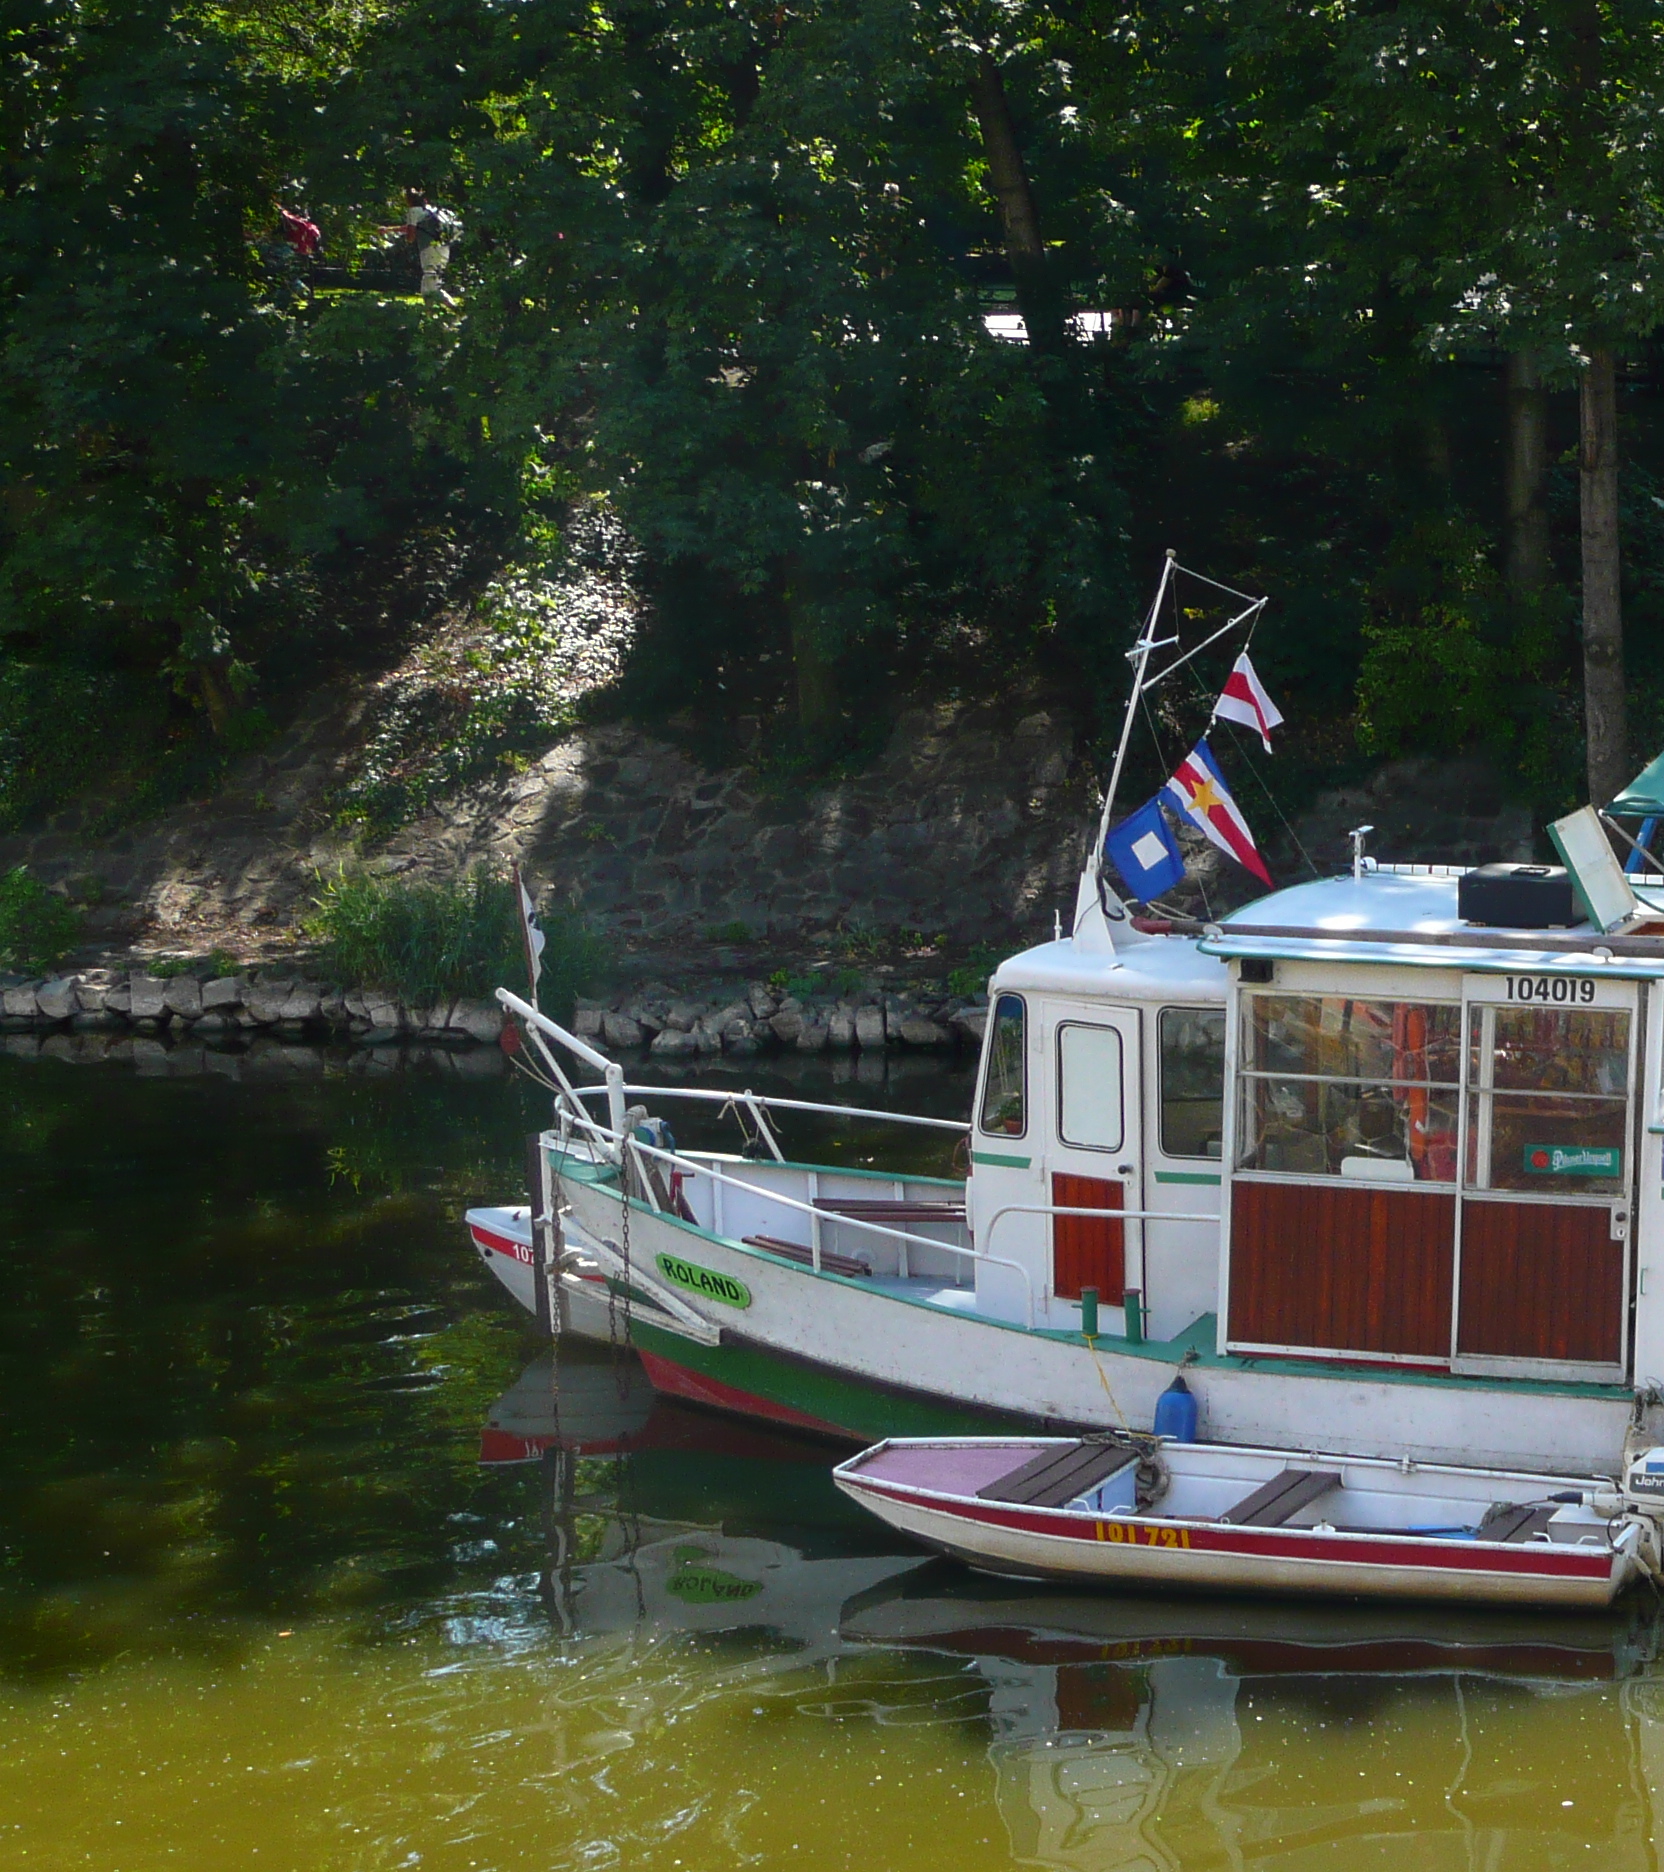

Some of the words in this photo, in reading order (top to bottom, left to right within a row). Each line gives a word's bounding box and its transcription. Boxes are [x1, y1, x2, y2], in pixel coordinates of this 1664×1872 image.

[1506, 976, 1595, 1003] 104019
[662, 1257, 740, 1301] ROLAND
[1095, 1521, 1137, 1544] 101
[1144, 1525, 1191, 1549] 721
